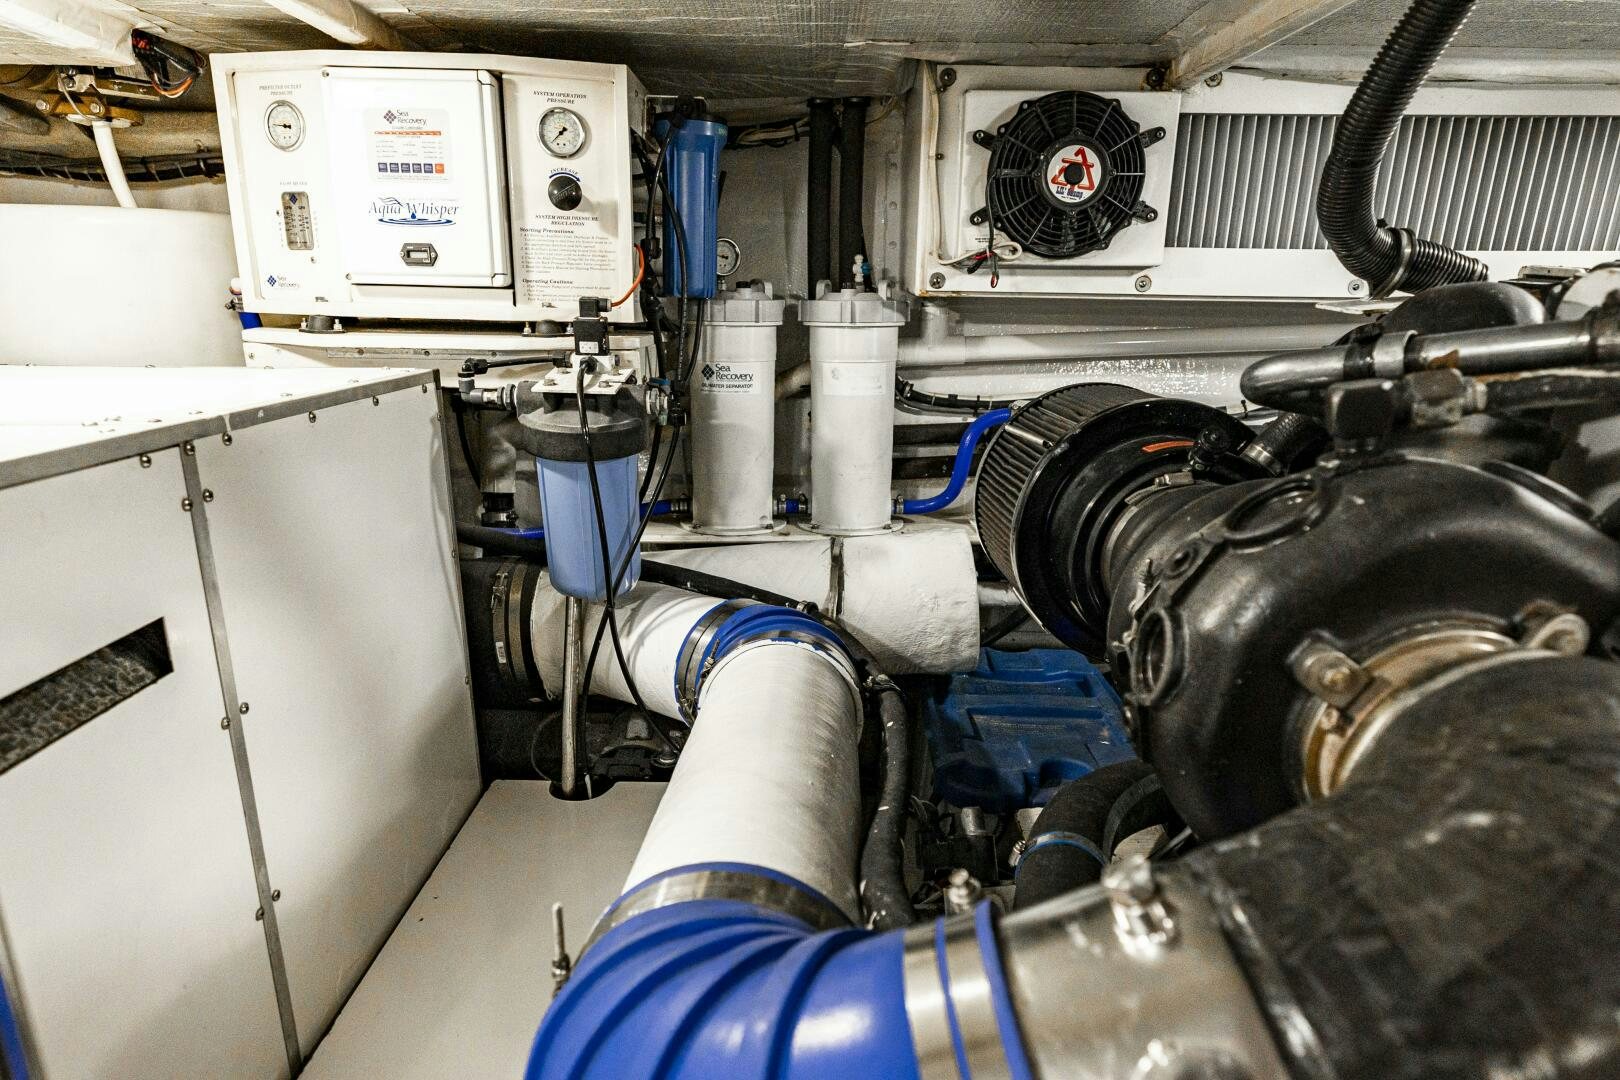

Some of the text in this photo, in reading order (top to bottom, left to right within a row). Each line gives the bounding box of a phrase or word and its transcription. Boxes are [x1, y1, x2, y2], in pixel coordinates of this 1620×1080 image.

[396, 109, 409, 117] Sea
[397, 116, 427, 125] Recovery
[550, 167, 578, 175] INCREASE
[369, 201, 459, 219] Aqua Whisper
[715, 363, 731, 372] Sea
[715, 372, 753, 382] Recovery
